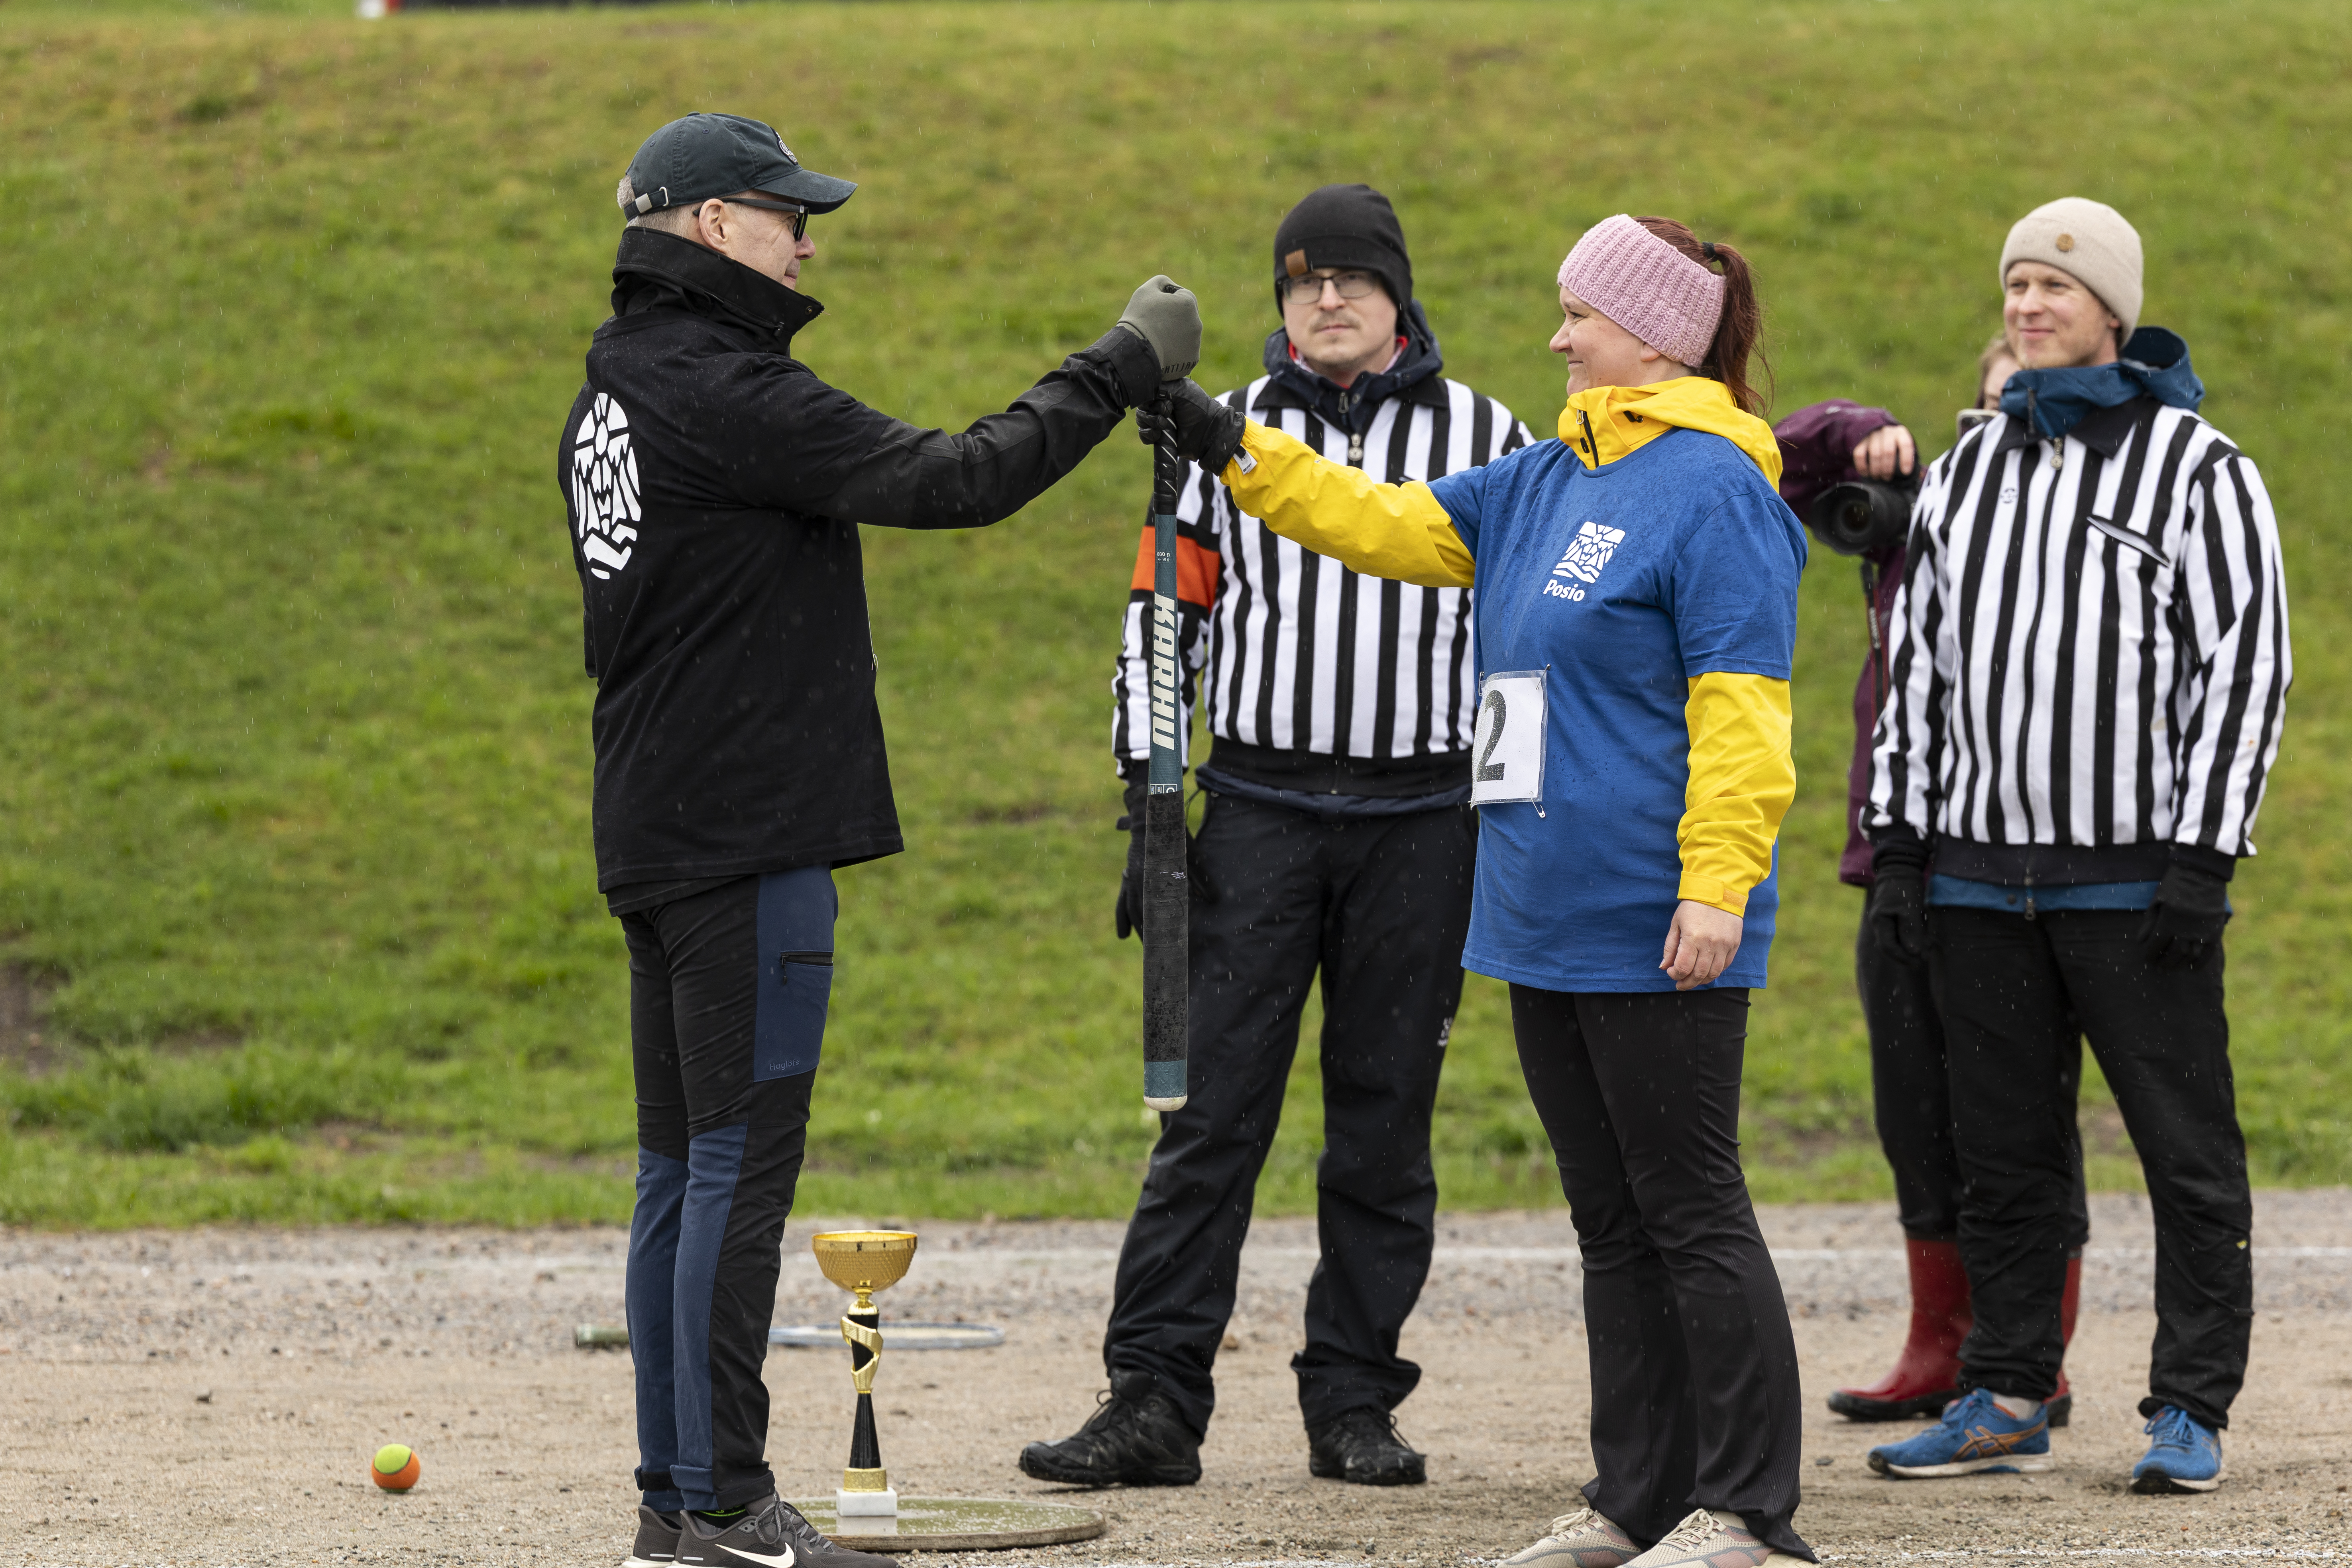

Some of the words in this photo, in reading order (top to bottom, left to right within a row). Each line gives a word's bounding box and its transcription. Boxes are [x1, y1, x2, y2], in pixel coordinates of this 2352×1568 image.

[1161, 360, 1199, 374] AHTIJAH
[1543, 579, 1585, 601] Posio
[1153, 592, 1175, 751] KARHU
[1477, 690, 1506, 782] 2
[769, 1059, 799, 1071] Haglöfs
